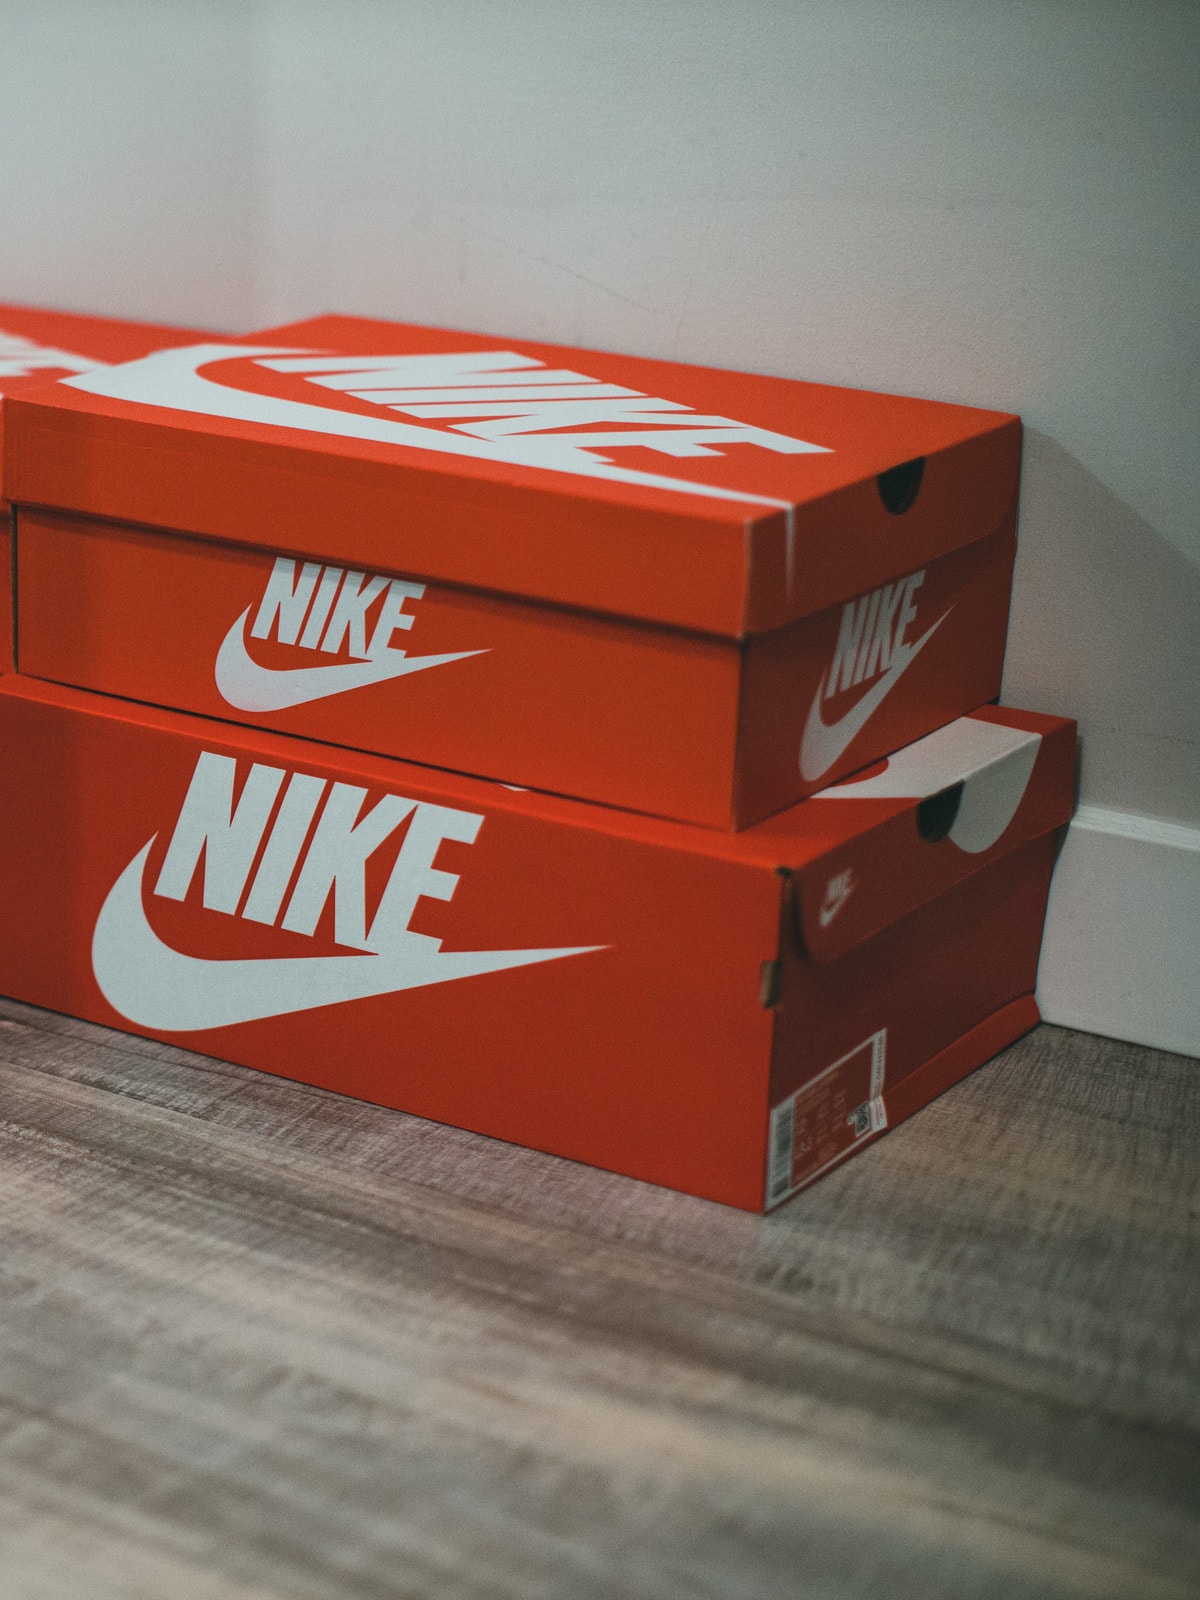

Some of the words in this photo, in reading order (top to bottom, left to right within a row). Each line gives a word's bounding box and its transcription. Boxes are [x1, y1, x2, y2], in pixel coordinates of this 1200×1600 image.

[252, 351, 835, 464] NIKE
[250, 556, 427, 662] NIKE
[824, 569, 926, 700] NIKE
[153, 750, 485, 956] NIKE
